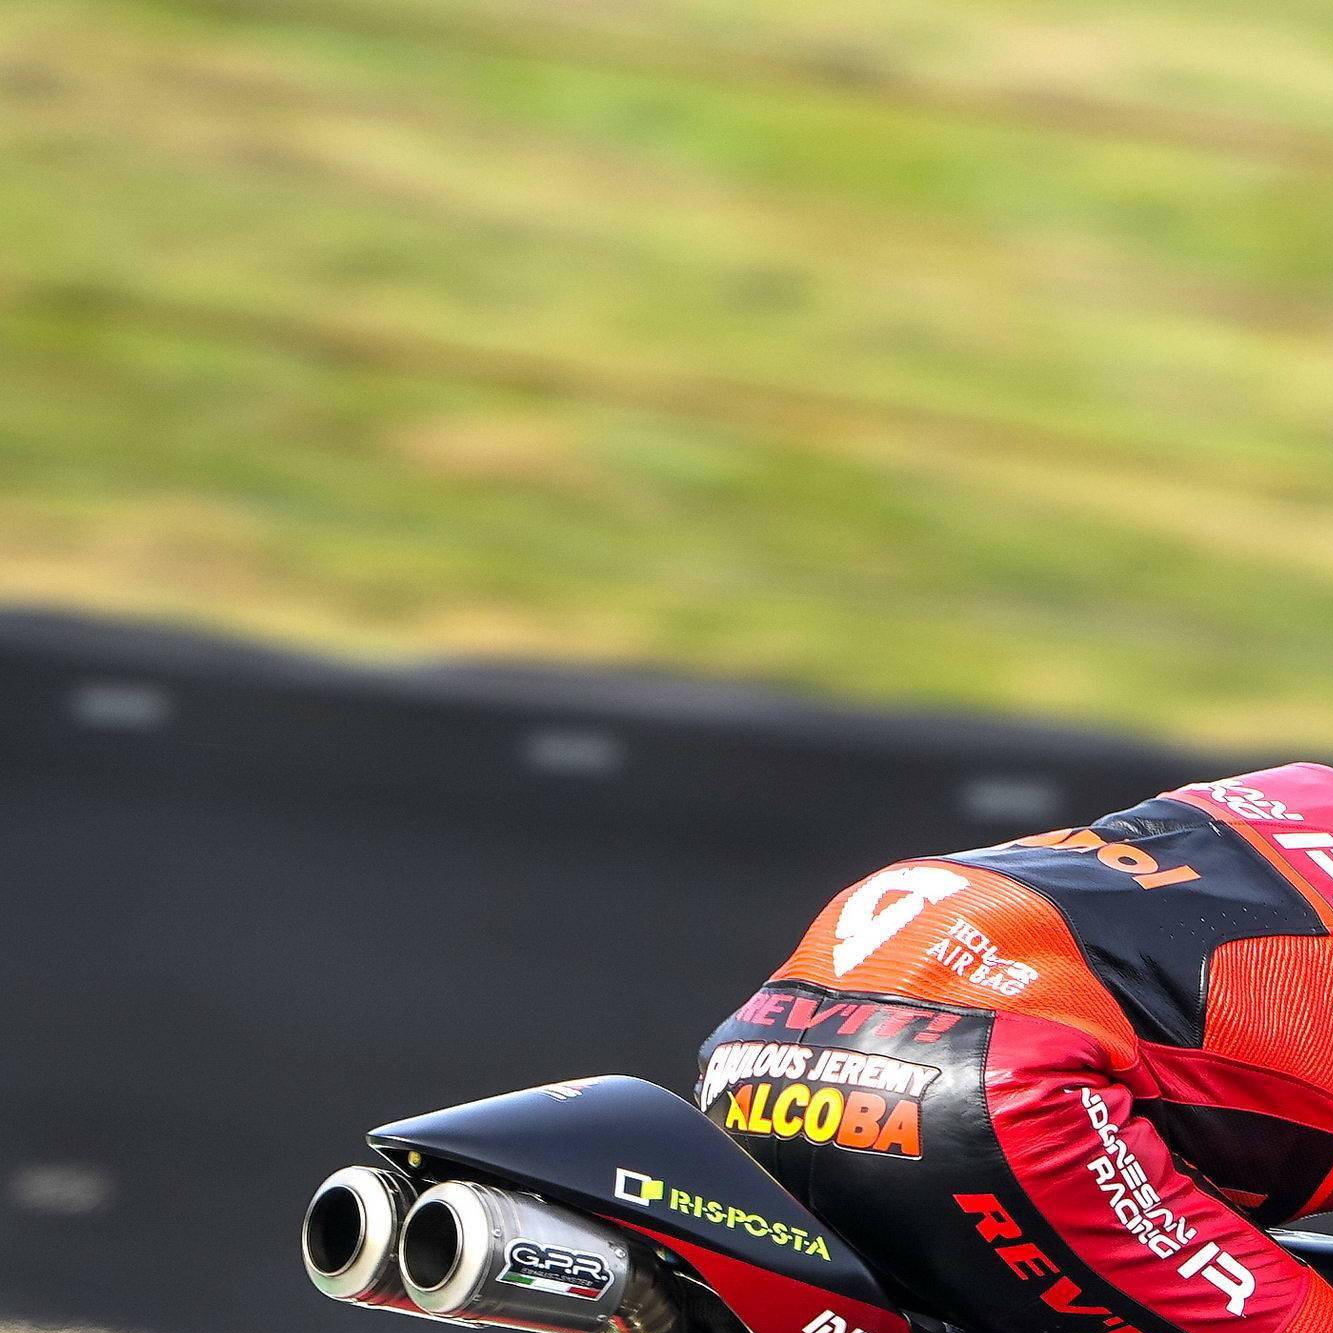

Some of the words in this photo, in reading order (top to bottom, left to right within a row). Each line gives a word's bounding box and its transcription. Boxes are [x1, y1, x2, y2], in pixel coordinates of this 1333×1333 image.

[925, 938, 975, 977] AIR
[968, 963, 1026, 996] BAG
[806, 1050, 942, 1097] JEREMY
[724, 1083, 922, 1157] ALCOBA
[668, 1187, 832, 1262] RISPOSTA
[1086, 1158, 1180, 1259] RACING
